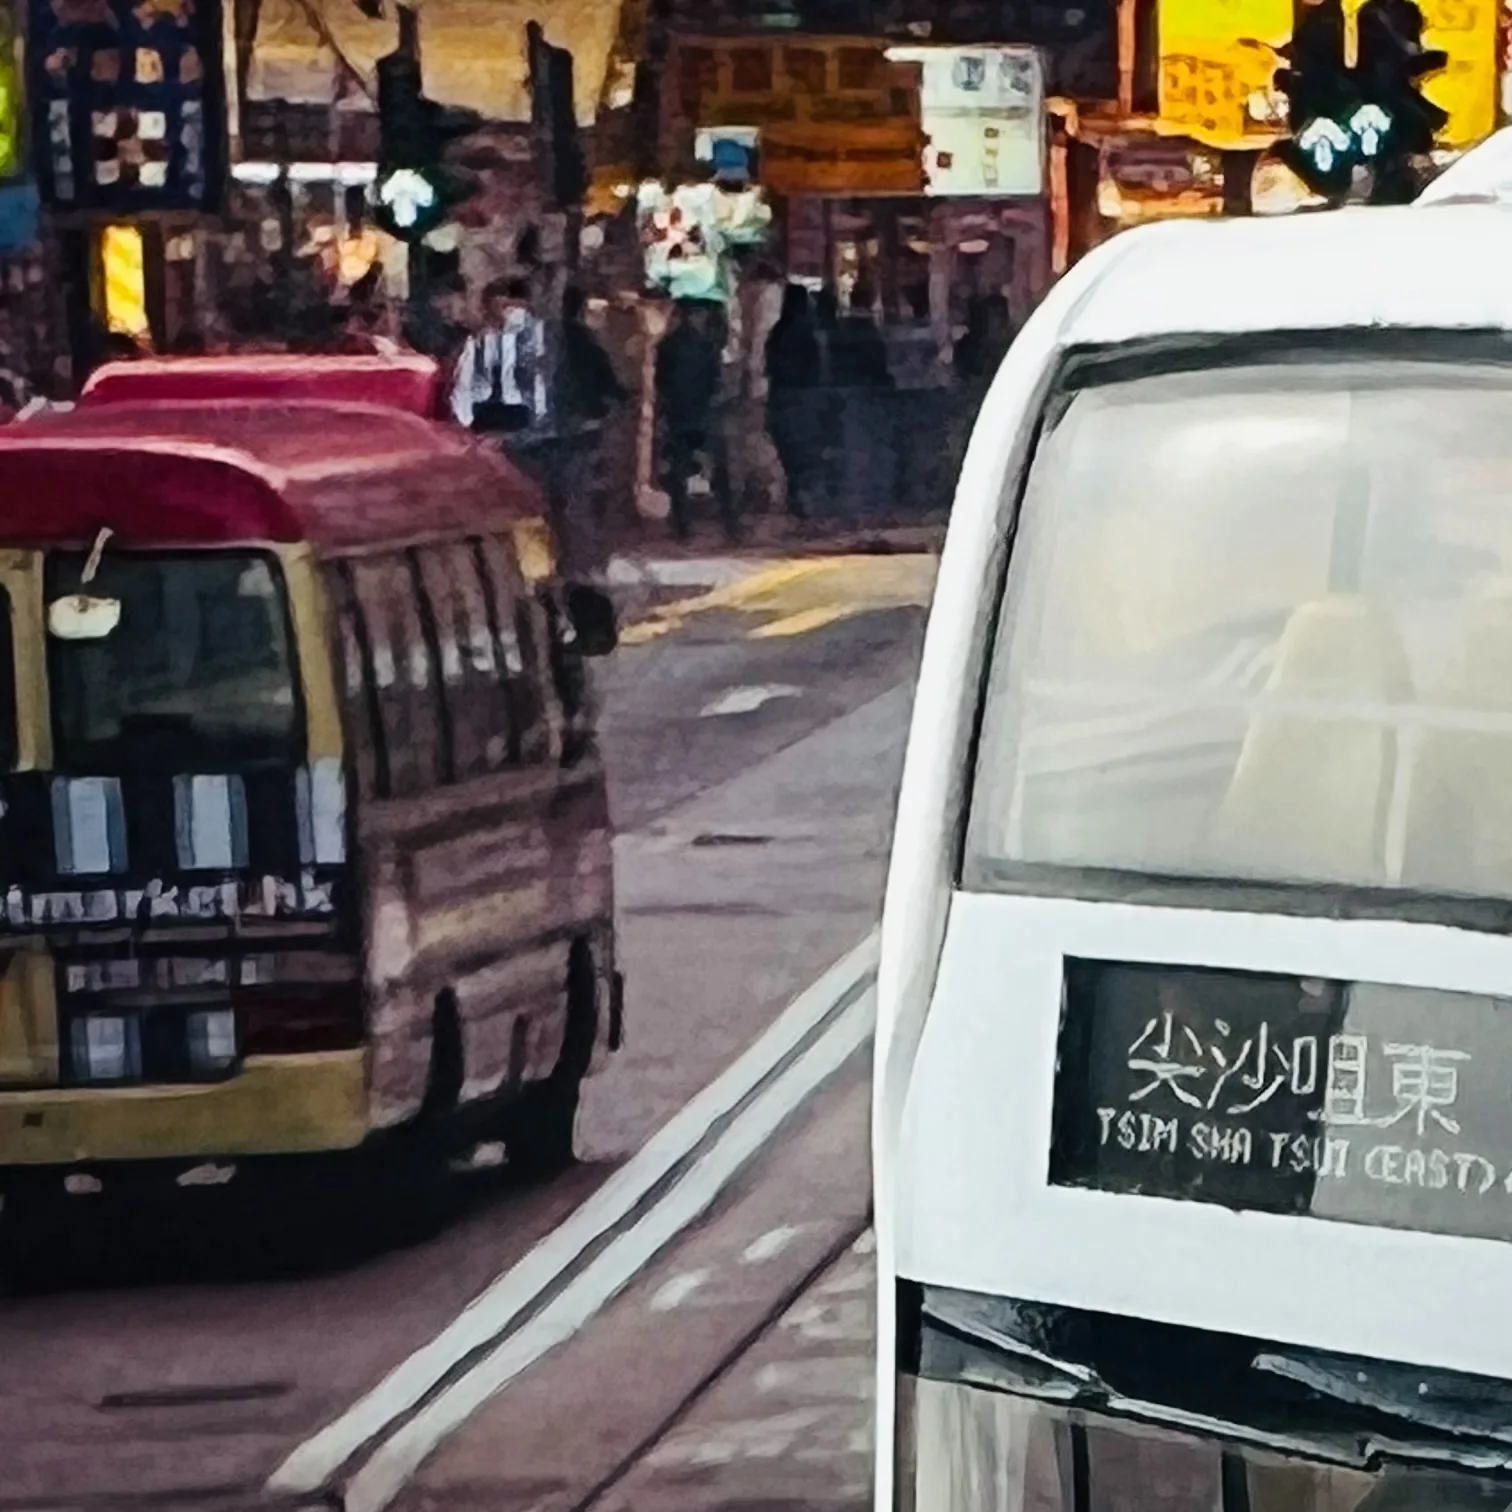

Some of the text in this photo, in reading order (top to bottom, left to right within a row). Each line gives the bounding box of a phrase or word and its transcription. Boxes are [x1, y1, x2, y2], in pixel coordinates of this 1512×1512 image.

[1127, 1011, 1471, 1135] 尖沙咀東
[1097, 1106, 1178, 1154] TSIM
[1364, 1143, 1497, 1195] (EAST)
